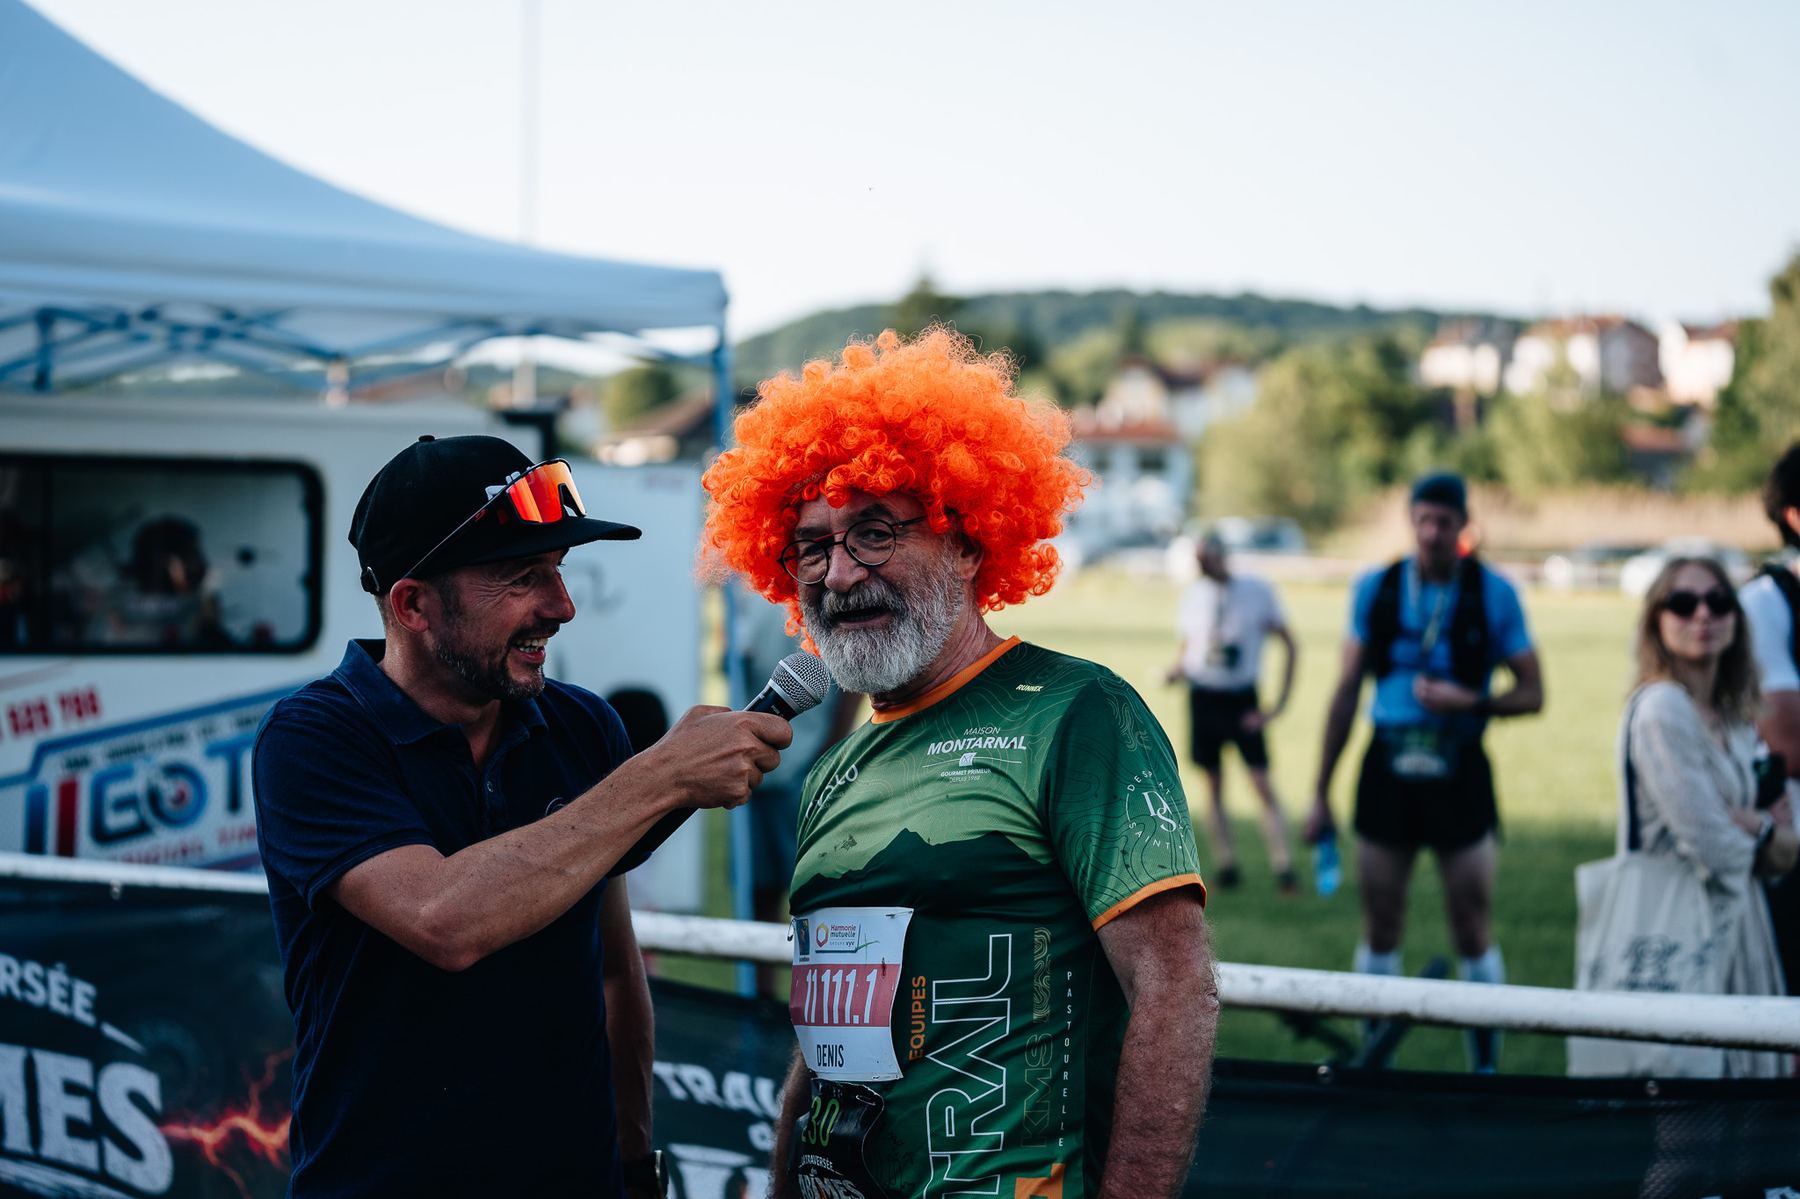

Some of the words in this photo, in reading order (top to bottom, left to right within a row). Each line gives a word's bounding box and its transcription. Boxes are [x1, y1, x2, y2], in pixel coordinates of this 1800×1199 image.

[963, 727, 1001, 736] MAISON
[927, 736, 1027, 756] MONTARNAL
[1128, 822, 1170, 849] SAINT
[908, 975, 926, 1061] EQUIPES
[815, 1044, 844, 1069] DENIS
[1020, 1032, 1053, 1148] KMS
